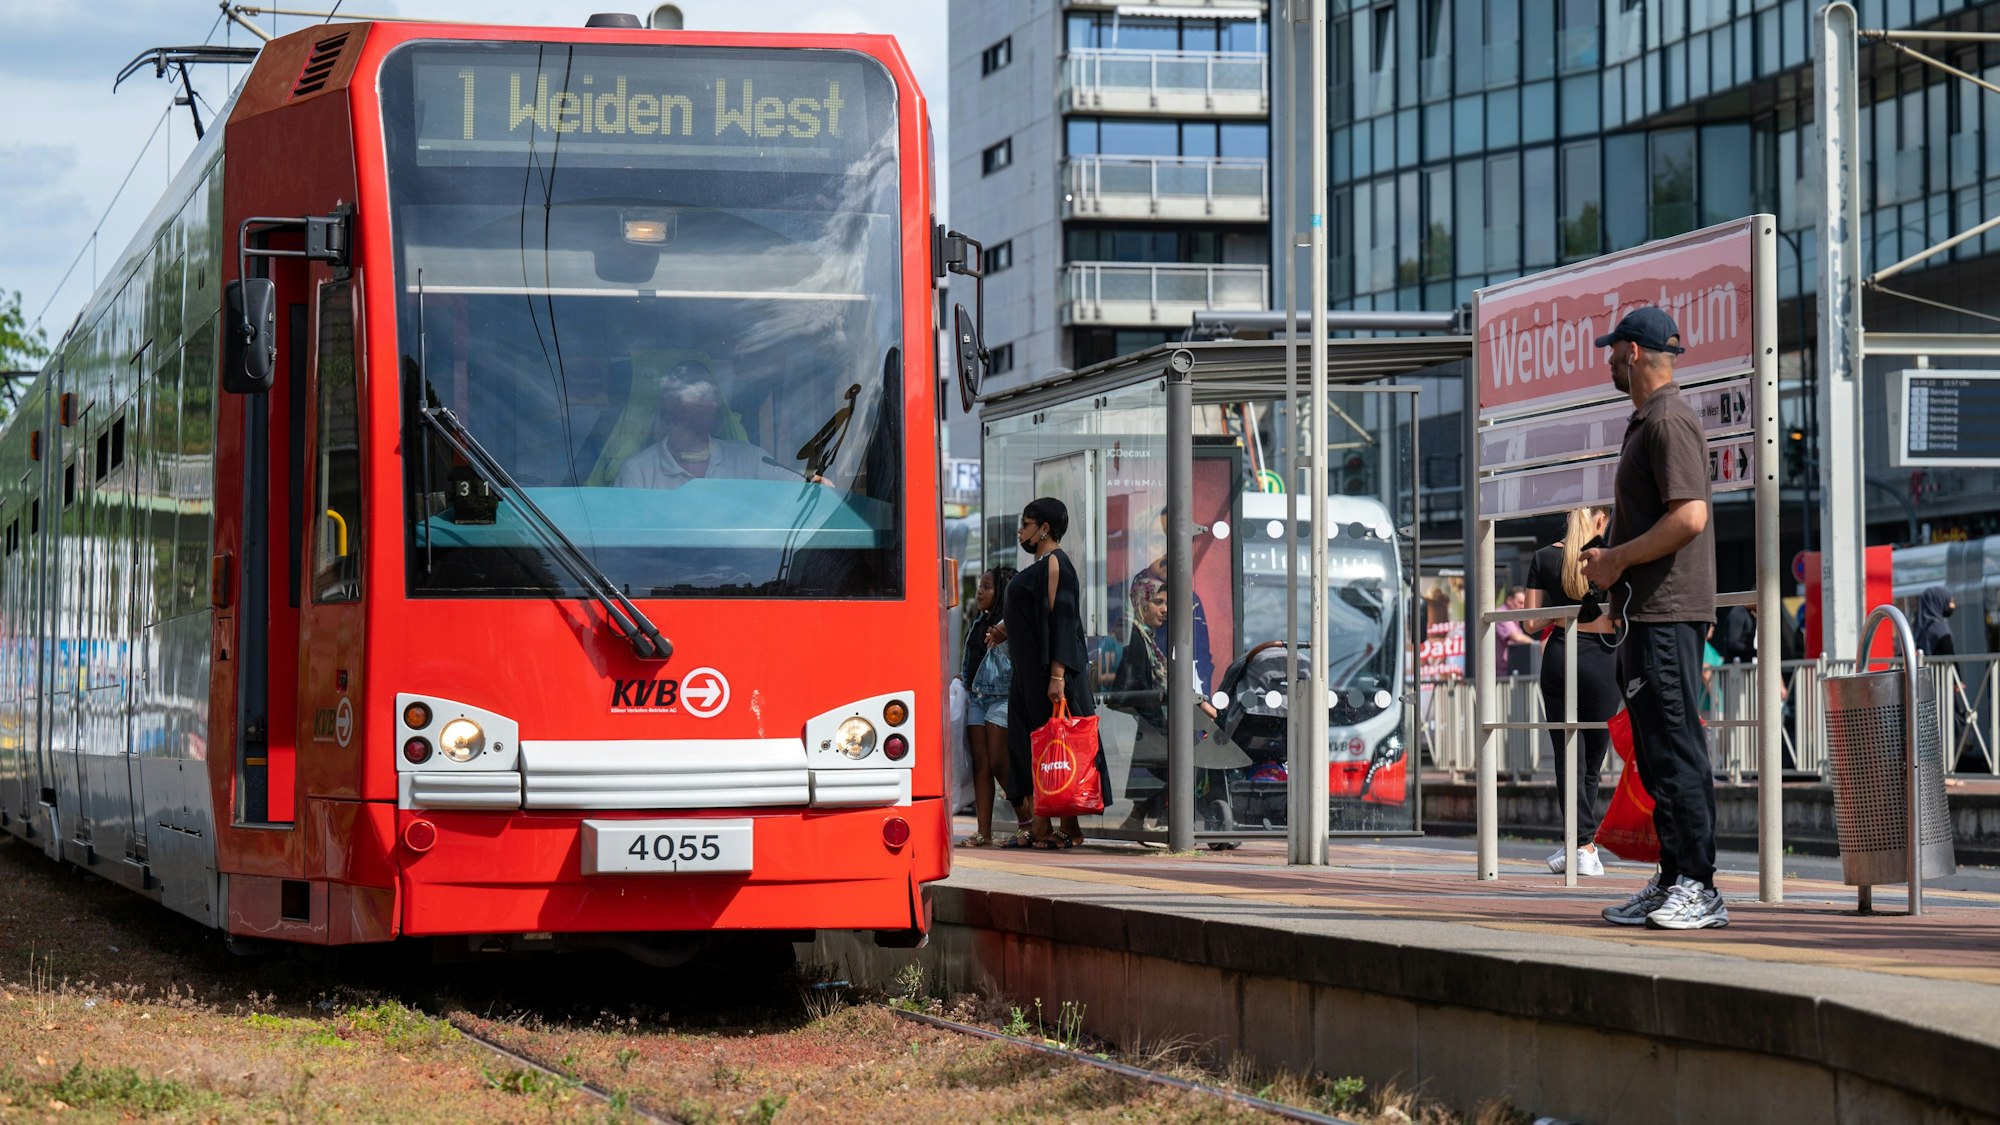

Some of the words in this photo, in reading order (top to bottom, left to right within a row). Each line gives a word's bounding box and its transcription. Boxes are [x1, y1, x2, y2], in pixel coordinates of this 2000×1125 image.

[458, 68, 475, 140] 1
[509, 72, 693, 136] Weiden
[715, 78, 845, 139] West
[1489, 303, 1594, 389] Weiden
[1707, 404, 1719, 417] West
[1106, 448, 1150, 458] JCDecaux
[460, 481, 470, 497] 3
[483, 481, 490, 497] 1
[1124, 479, 1164, 487] EINMAL
[611, 680, 678, 706] KVB
[628, 834, 720, 861] 4055
